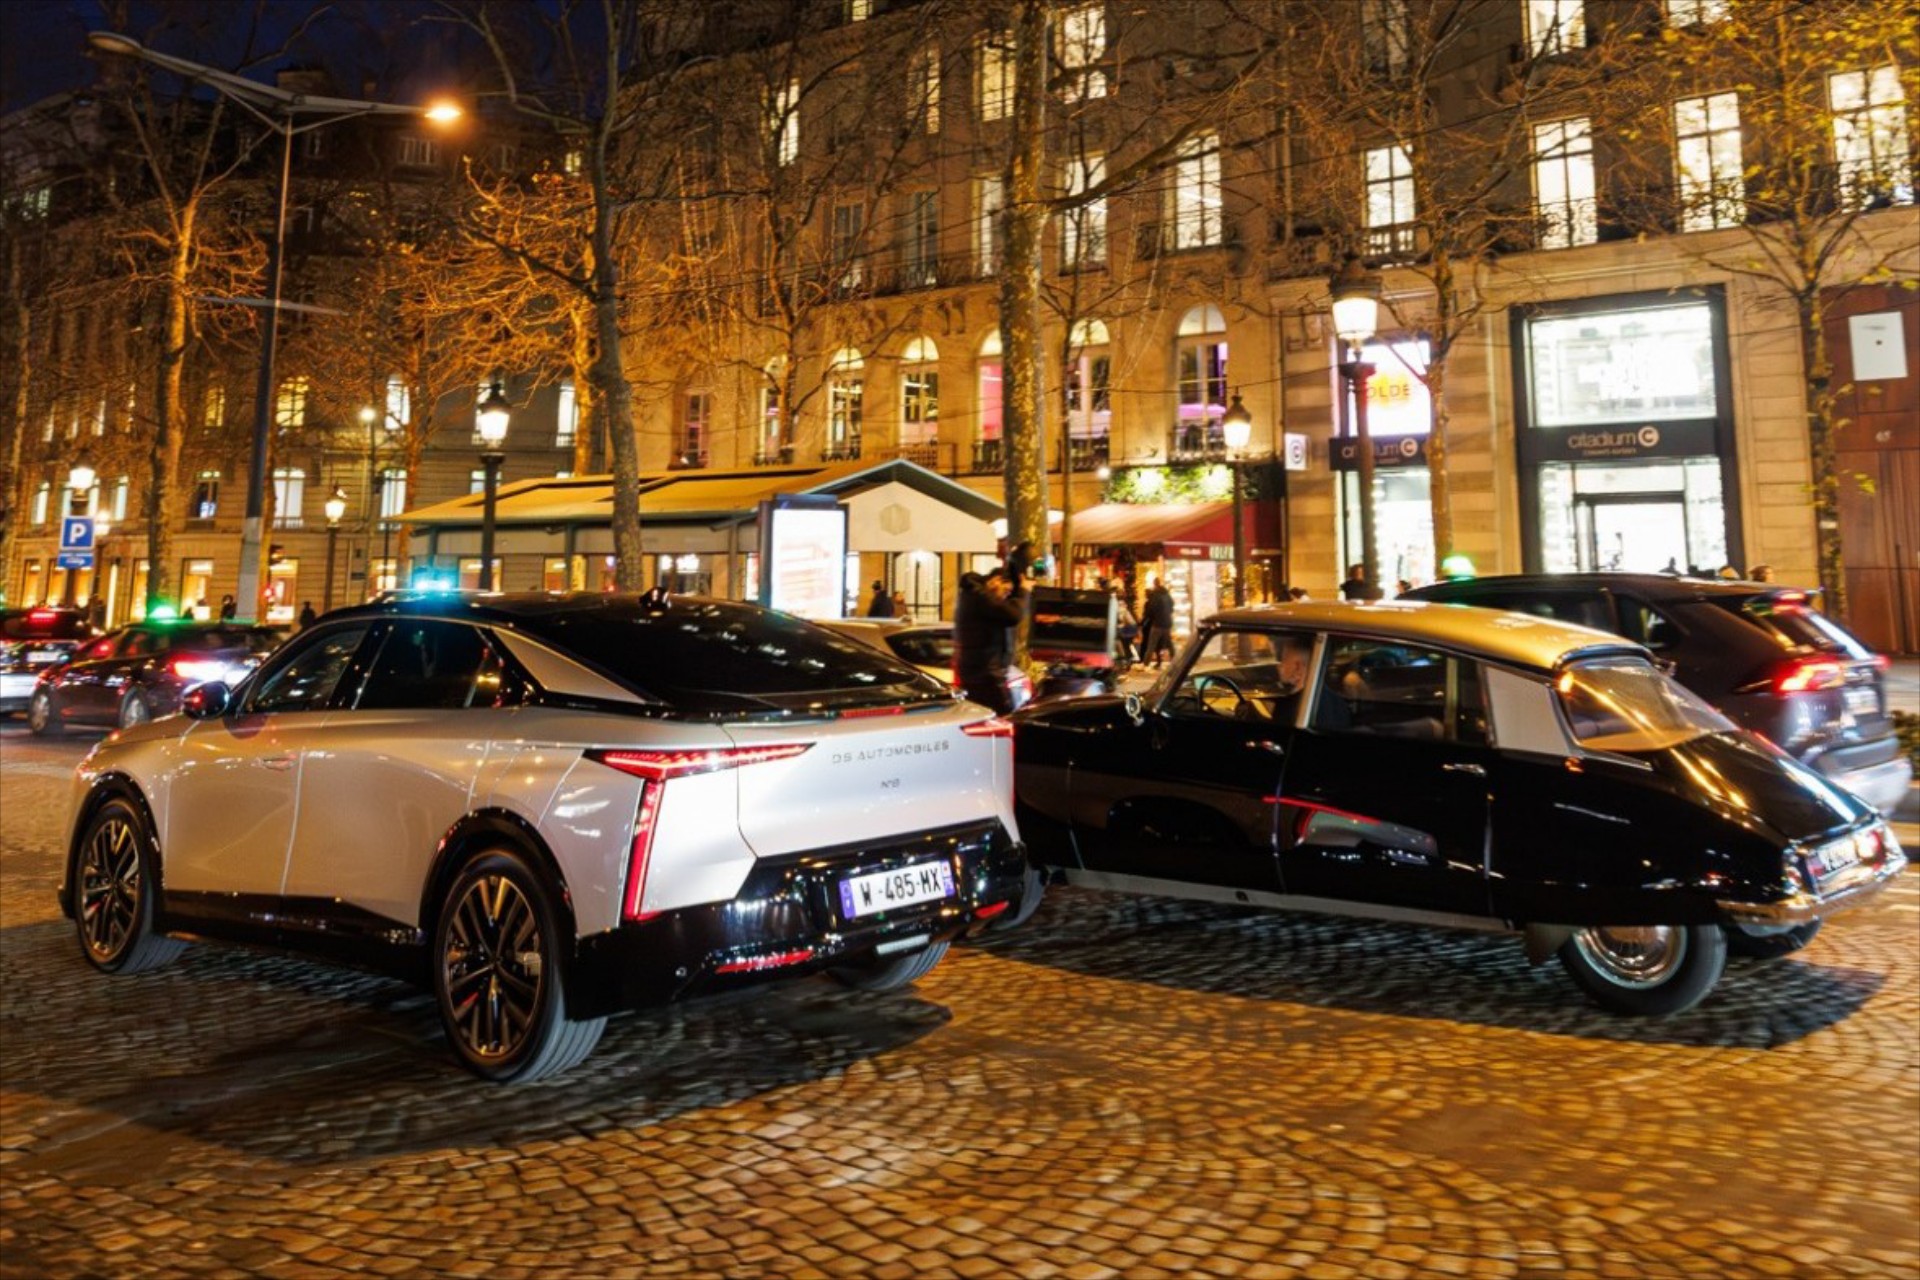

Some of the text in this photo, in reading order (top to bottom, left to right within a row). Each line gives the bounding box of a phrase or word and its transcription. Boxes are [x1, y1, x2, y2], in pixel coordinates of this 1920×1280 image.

[69, 522, 86, 543] P
[832, 740, 949, 764] DS AUTOMOBILES
